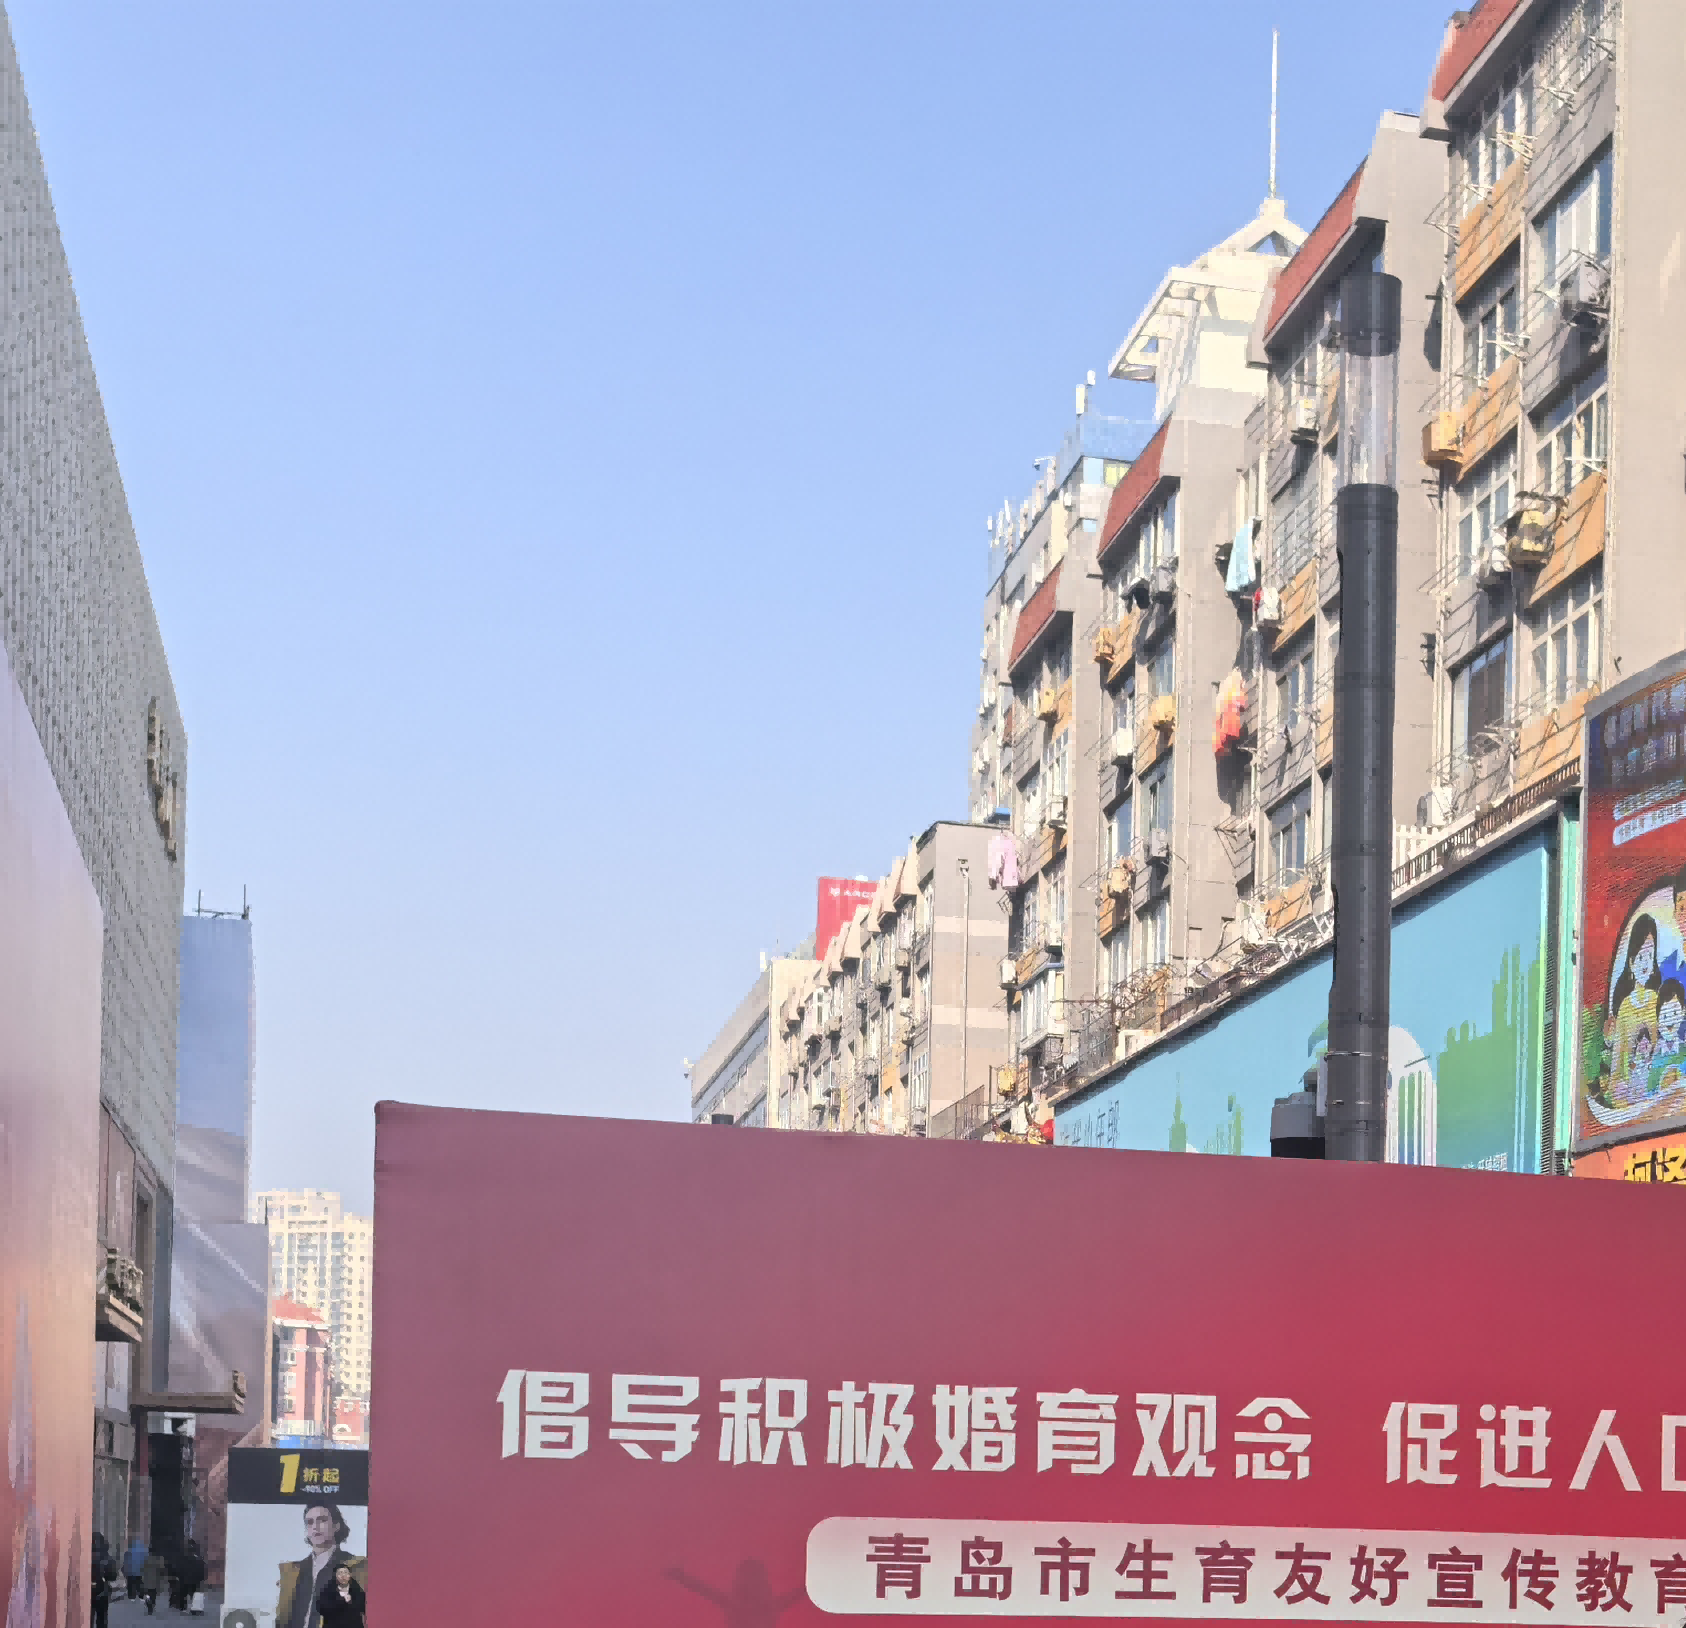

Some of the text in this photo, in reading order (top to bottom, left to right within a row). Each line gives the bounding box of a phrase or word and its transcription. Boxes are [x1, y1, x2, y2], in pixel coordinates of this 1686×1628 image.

[495, 1368, 1314, 1480] 倡导积极婚育观念
[280, 1453, 300, 1493] 1
